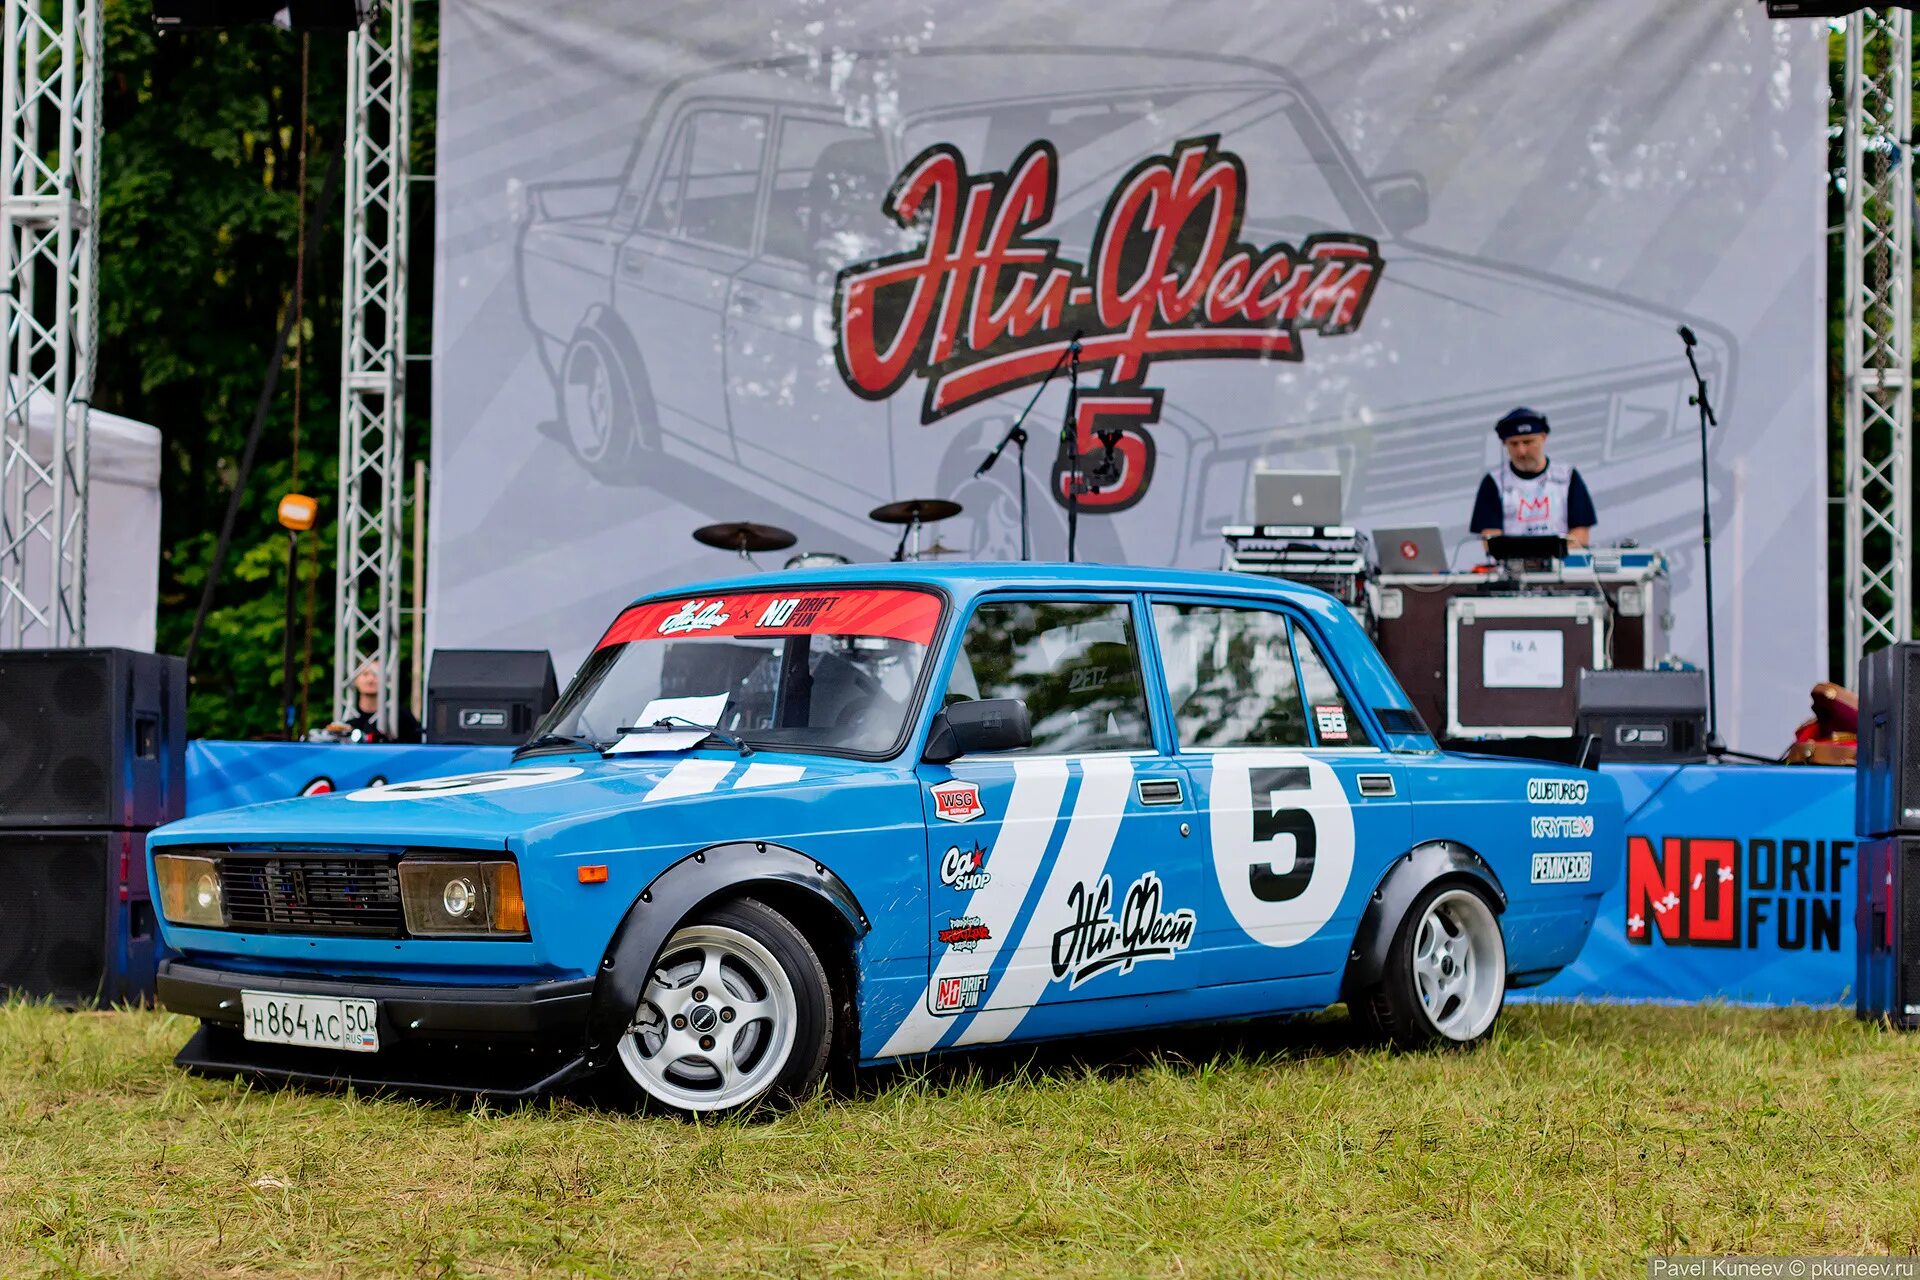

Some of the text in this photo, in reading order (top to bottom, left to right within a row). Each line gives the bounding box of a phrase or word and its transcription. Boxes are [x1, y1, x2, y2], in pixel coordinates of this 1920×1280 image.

[842, 145, 1373, 410] Жи-Фест
[1061, 396, 1153, 506] 5
[754, 599, 801, 627] NO
[800, 597, 841, 613] DRIFT
[788, 612, 818, 628] FUN
[941, 792, 973, 807] WSG
[1529, 781, 1587, 801] CLUBTURBO
[1248, 766, 1317, 903] 5
[1532, 819, 1591, 836] KRYTEX
[954, 872, 991, 892] SHOP
[1626, 836, 1855, 948] NO DRIF
[1051, 876, 1193, 985] Жи-Фест
[1748, 897, 1841, 951] FUN
[937, 975, 988, 1009] NO DRIFT
[960, 992, 979, 1008] FUN
[345, 1004, 369, 1032] 50
[345, 1033, 362, 1046] RUS
